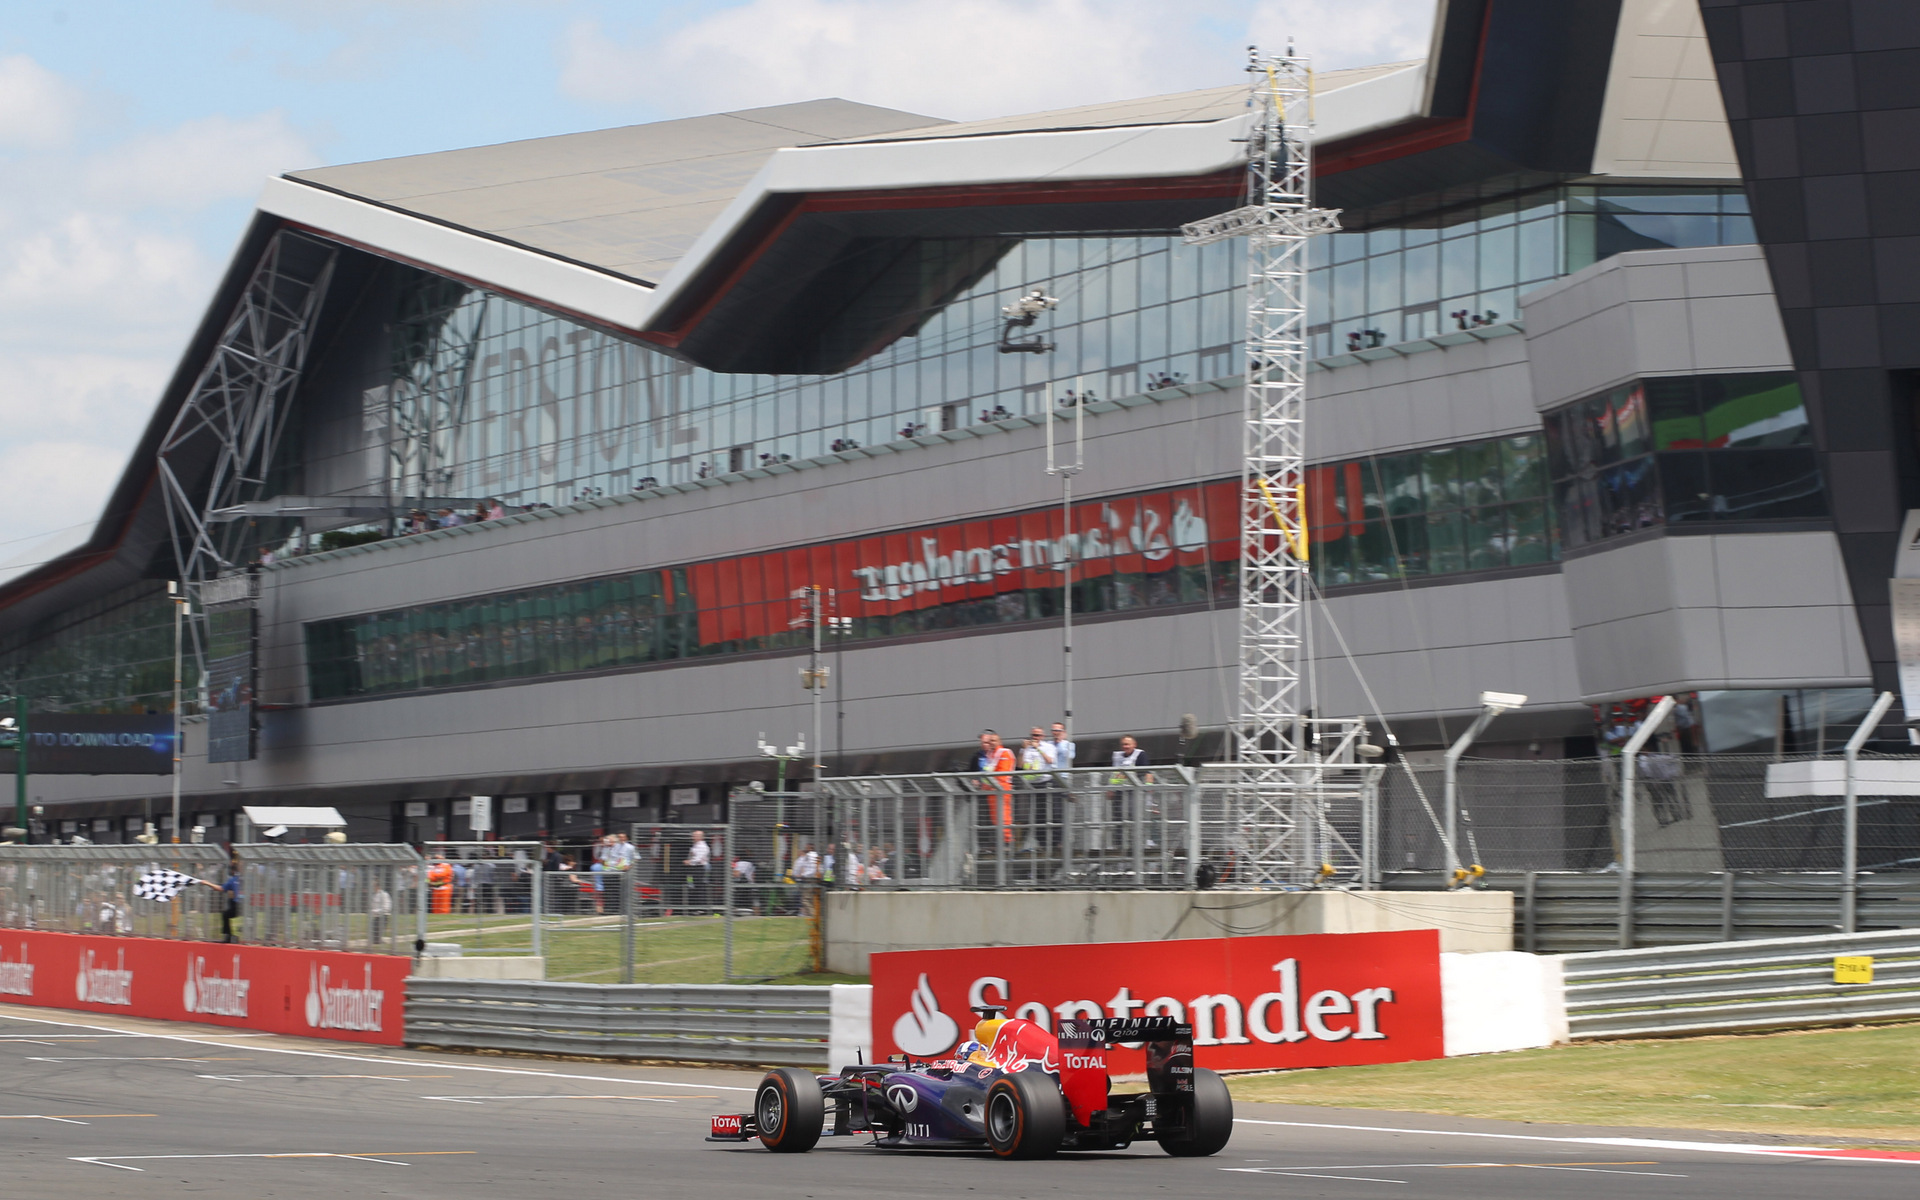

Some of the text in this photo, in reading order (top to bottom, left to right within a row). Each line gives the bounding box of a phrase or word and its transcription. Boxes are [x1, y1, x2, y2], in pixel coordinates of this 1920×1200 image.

[34, 733, 57, 746] TO
[59, 733, 155, 747] DOWNLOAD
[86, 946, 133, 1006] Santander
[195, 954, 249, 1017] Santander
[320, 962, 384, 1032] Santander
[1086, 1017, 1172, 1030] INFINITI
[1113, 1030, 1138, 1038] Q100
[948, 1060, 972, 1073] Bull
[1064, 1053, 1106, 1069] TOTAL
[712, 1115, 742, 1128] TOTAL
